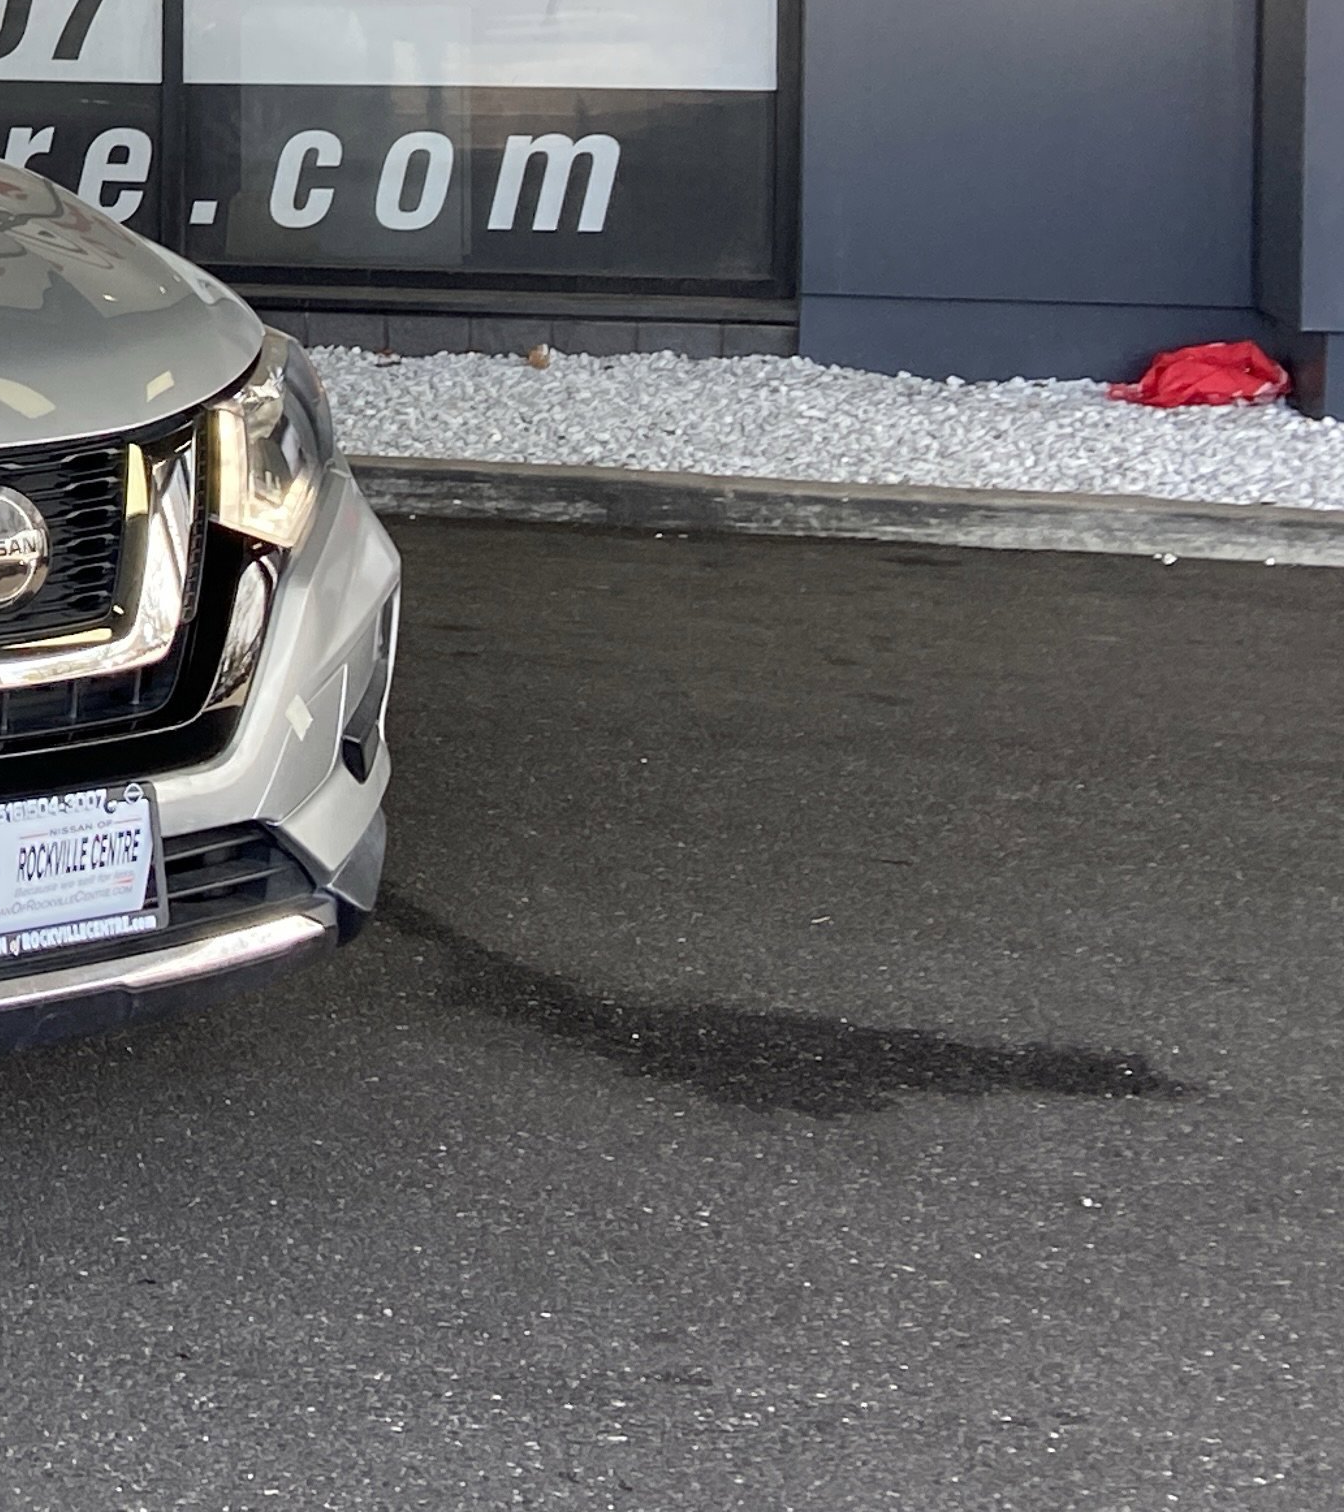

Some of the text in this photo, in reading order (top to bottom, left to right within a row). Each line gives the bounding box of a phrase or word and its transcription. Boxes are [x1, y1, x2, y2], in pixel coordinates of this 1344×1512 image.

[50, 819, 113, 836] NISSAN OF
[17, 829, 141, 881] ROCKVILLE CENTRE
